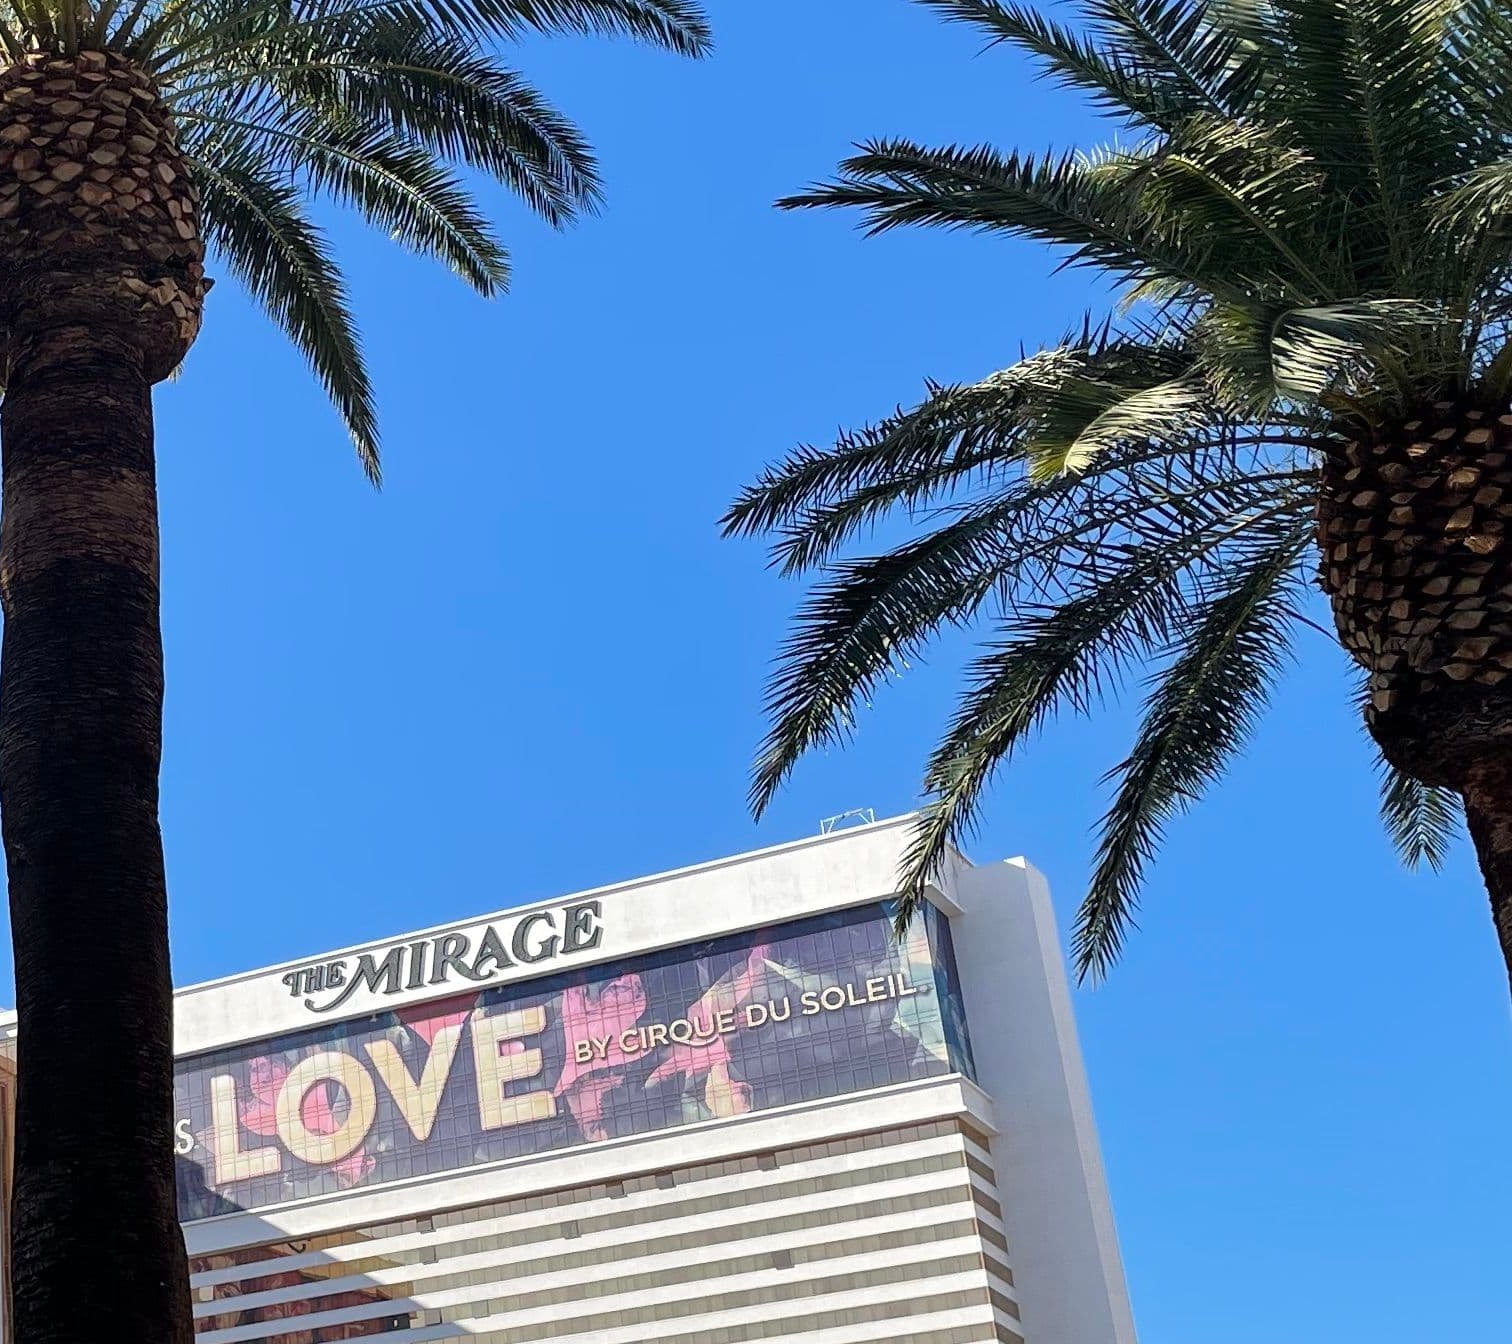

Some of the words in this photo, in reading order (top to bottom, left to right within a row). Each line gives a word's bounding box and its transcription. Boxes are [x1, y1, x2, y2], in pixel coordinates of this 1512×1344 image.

[282, 960, 348, 997] THE
[305, 900, 604, 1013] MIRAGE
[210, 1005, 558, 1185] LOVE
[574, 1035, 612, 1063] BY
[619, 1009, 736, 1057] CIRQUE
[745, 997, 792, 1028] DU
[800, 972, 917, 1016] SOLEIL
